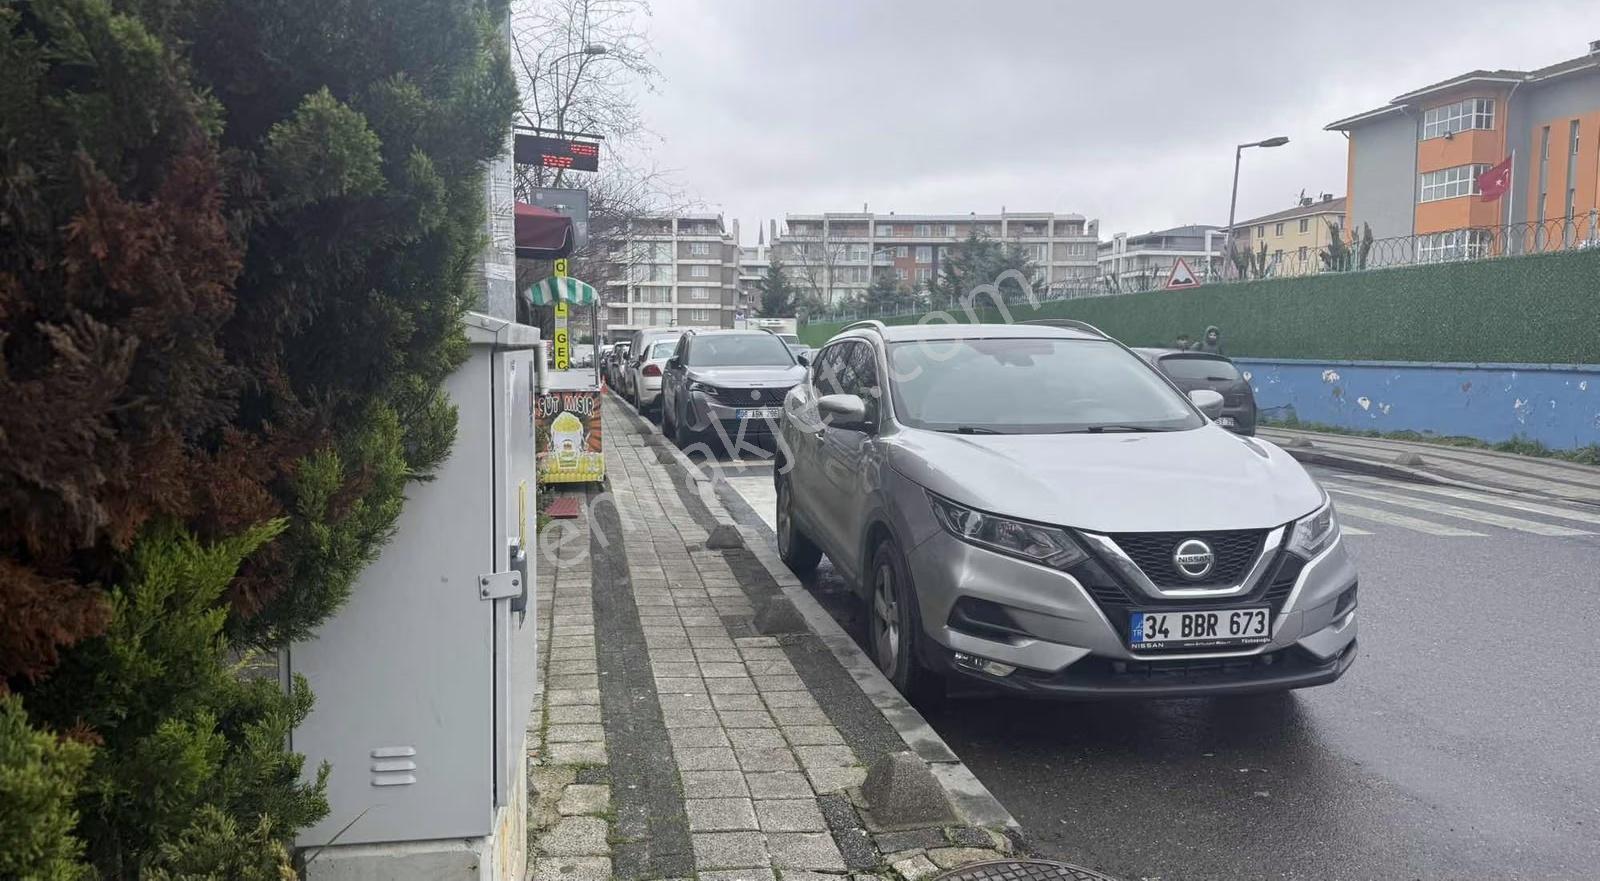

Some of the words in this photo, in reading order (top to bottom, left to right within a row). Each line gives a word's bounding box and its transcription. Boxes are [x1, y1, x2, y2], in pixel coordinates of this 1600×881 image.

[1177, 556, 1211, 564] NISSAN
[1145, 615, 1170, 639] 34
[1181, 614, 1218, 637] BBR
[1229, 611, 1265, 635] 673
[1132, 629, 1143, 637] TR
